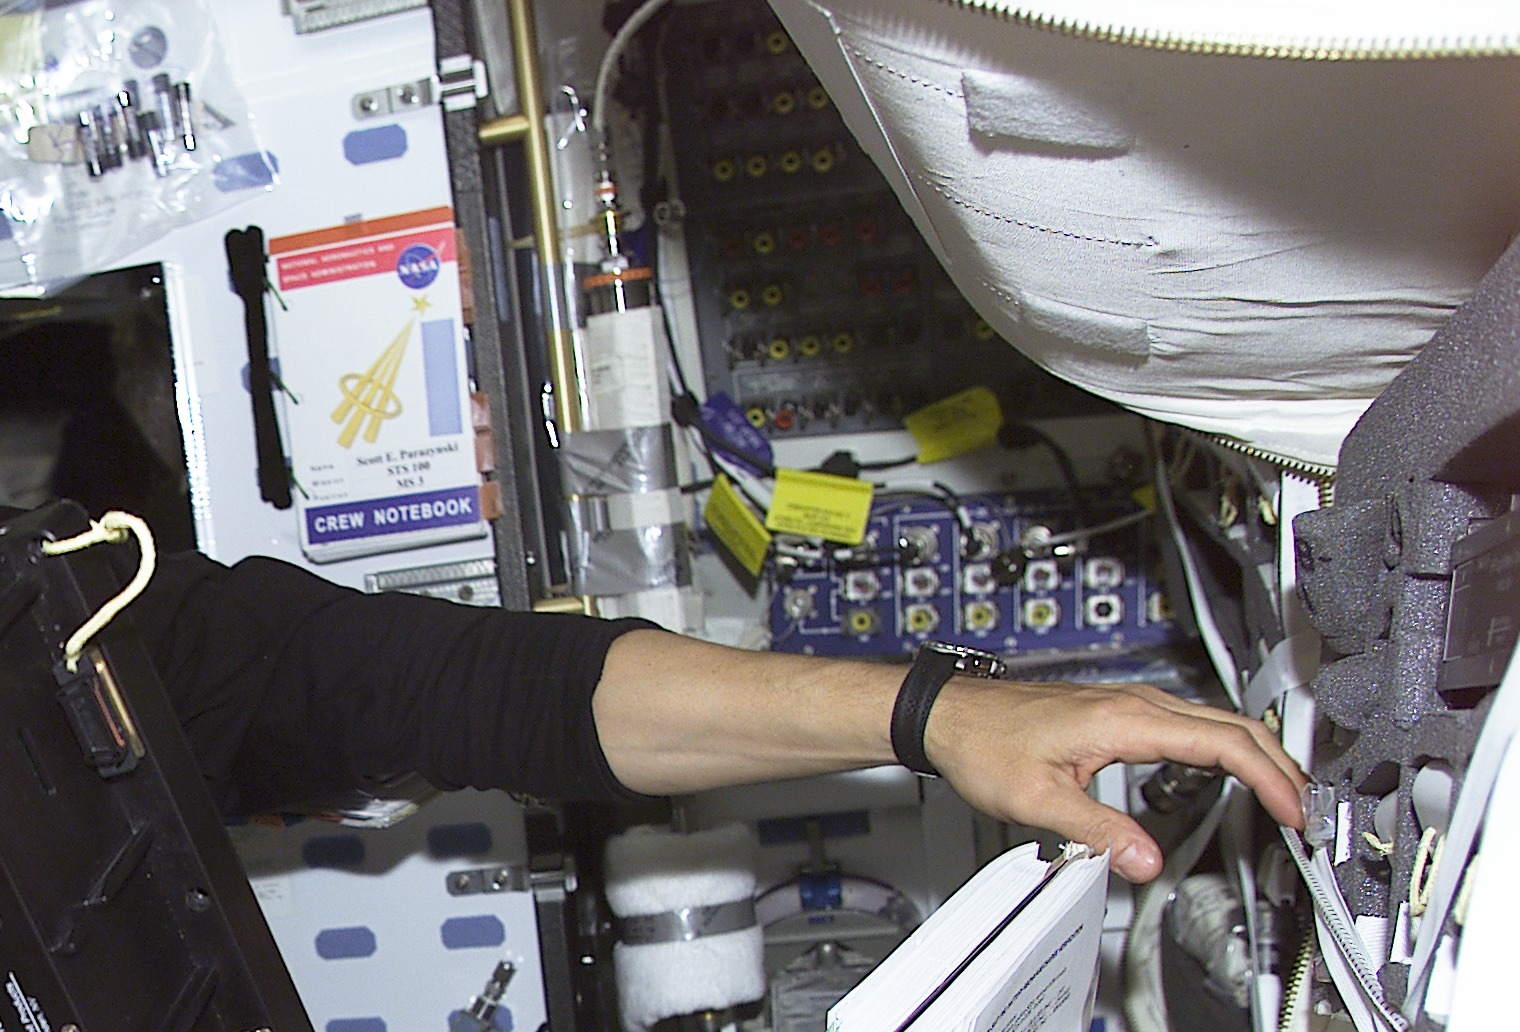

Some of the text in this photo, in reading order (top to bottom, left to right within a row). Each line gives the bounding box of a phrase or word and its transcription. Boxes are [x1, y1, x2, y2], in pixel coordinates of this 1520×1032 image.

[399, 260, 439, 276] NASA
[356, 455, 383, 466] Scott
[387, 460, 430, 475] STS 100
[397, 478, 415, 488] MS
[314, 496, 473, 533] CREW NOTEBOOK
